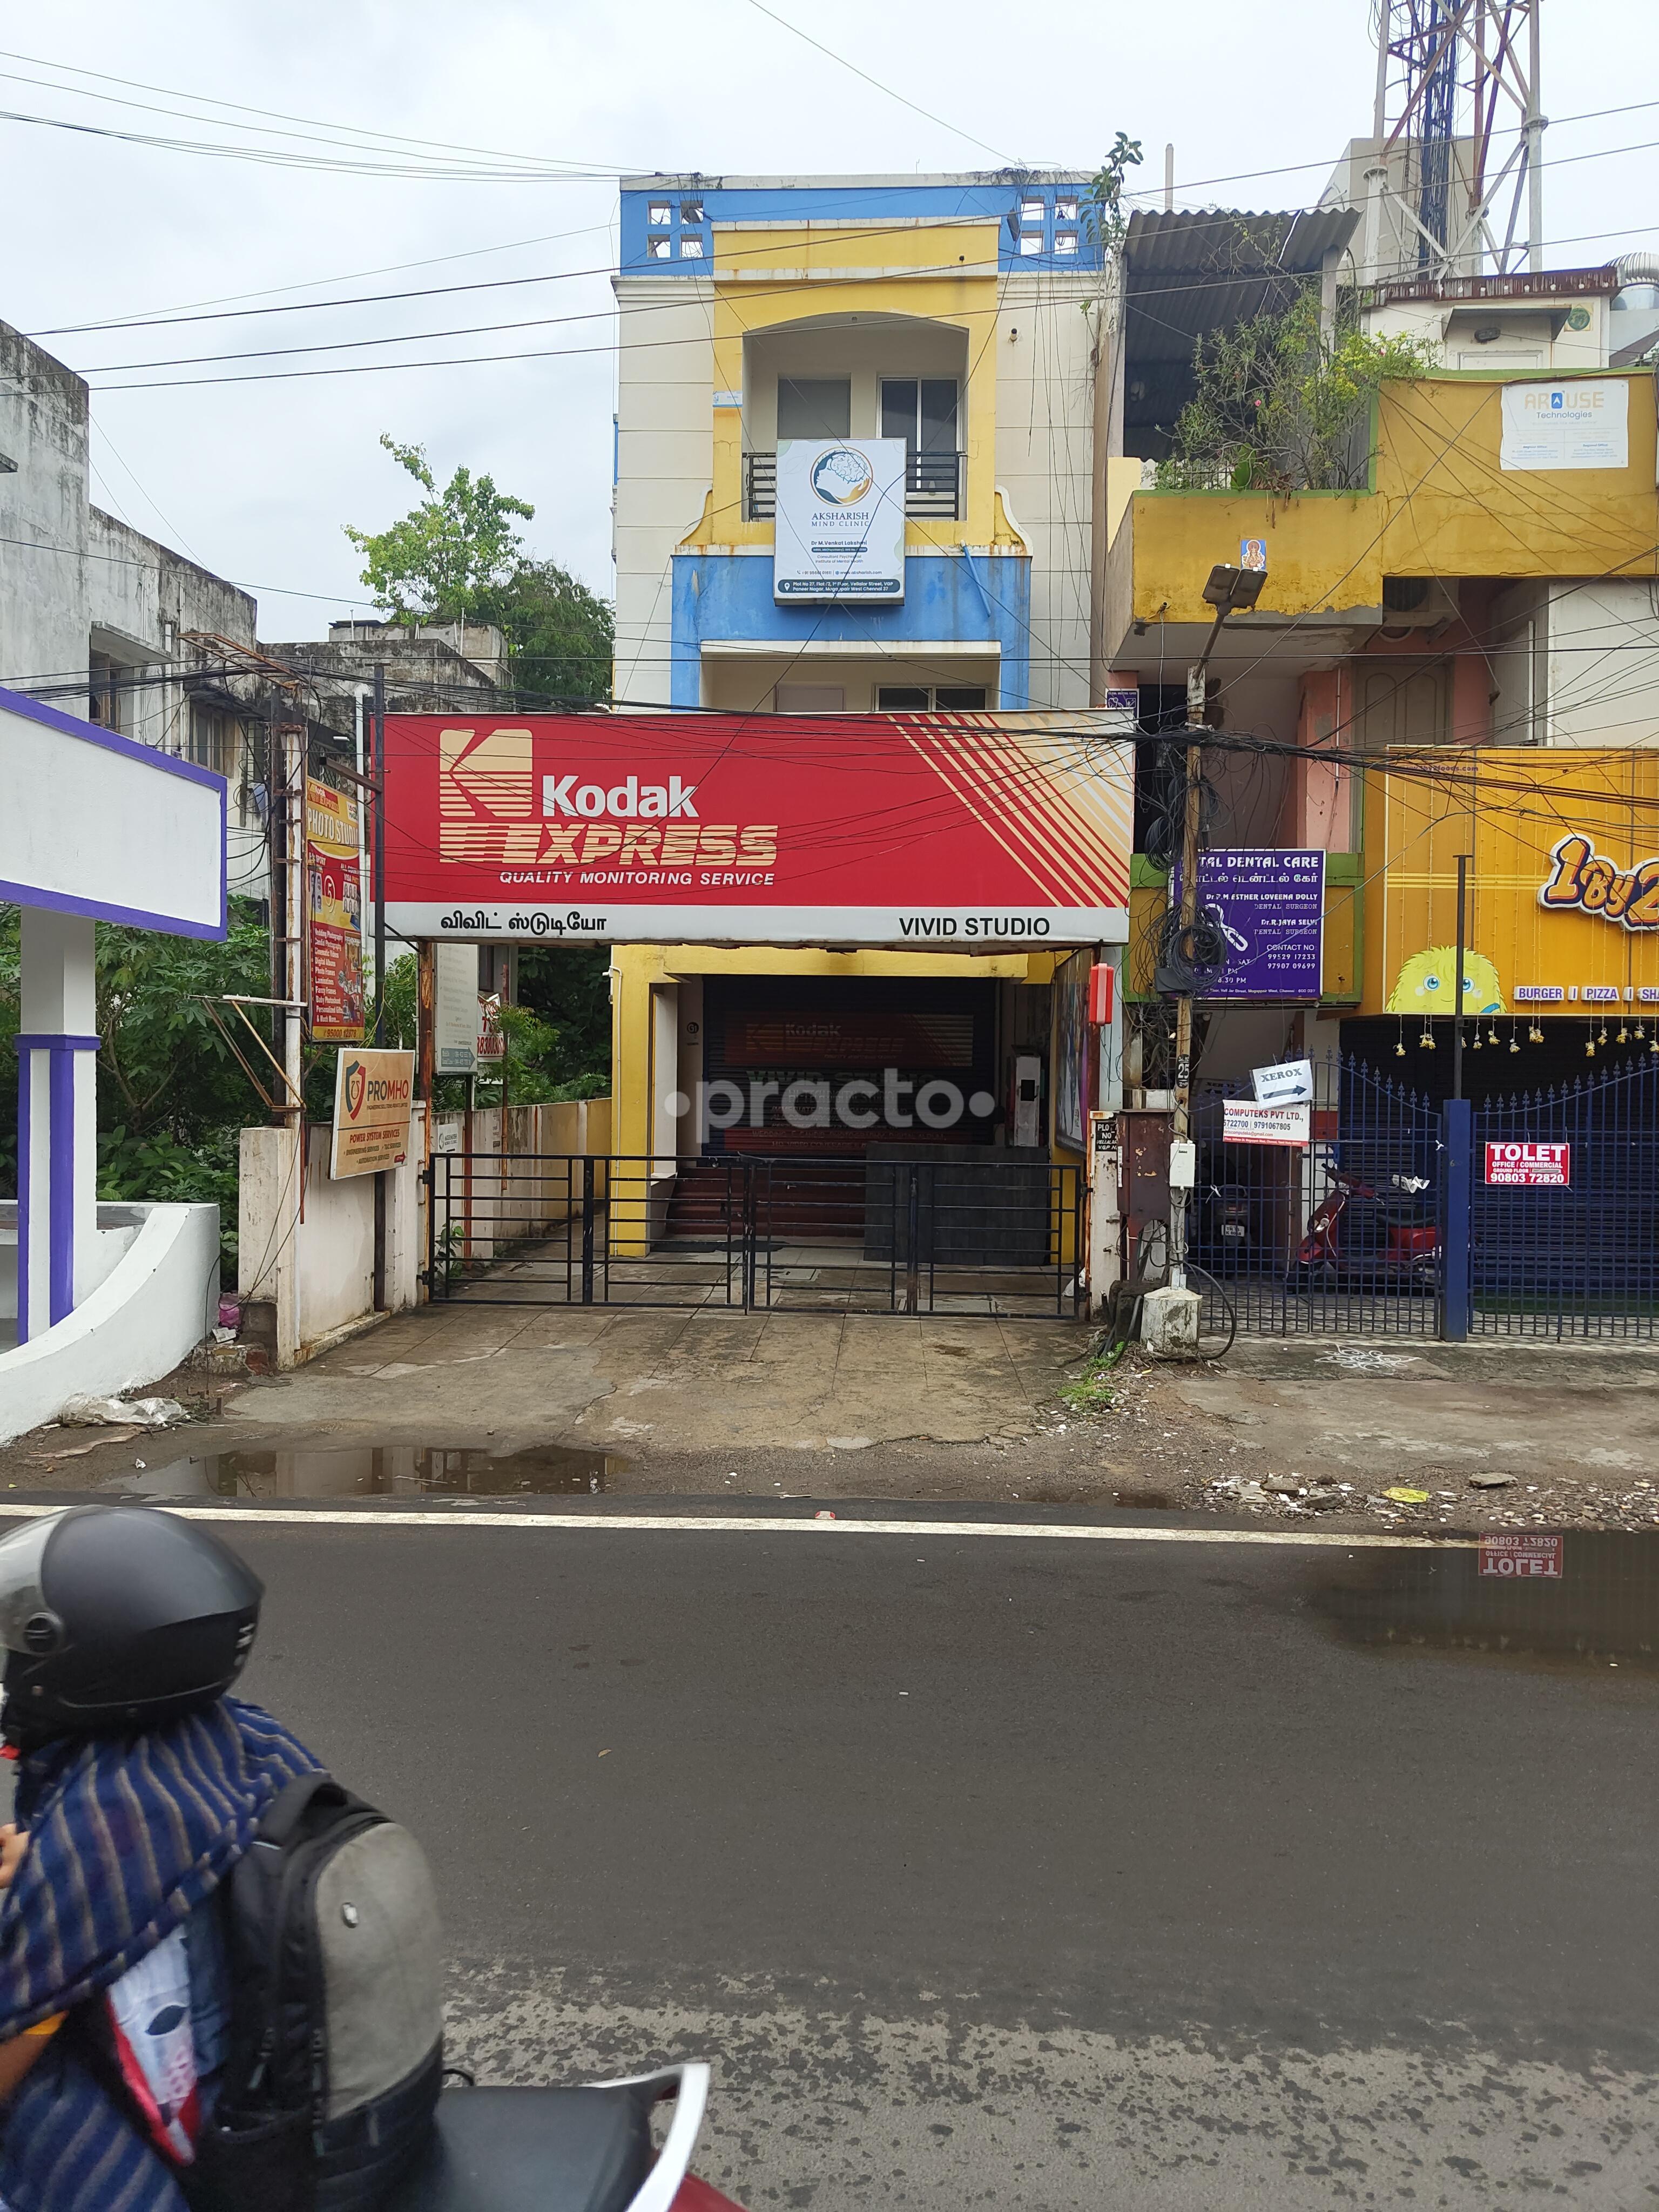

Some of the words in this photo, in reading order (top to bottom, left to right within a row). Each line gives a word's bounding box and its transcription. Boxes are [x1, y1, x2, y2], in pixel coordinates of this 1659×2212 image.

[1536, 411, 1593, 420] Technologies
[811, 512, 869, 520] AKSHARISH
[543, 775, 699, 818] Kodak
[307, 807, 335, 841] PHOTO
[440, 822, 778, 867] EXPRESS
[1227, 857, 1280, 868] DENTAL
[1284, 857, 1319, 868] CARE
[500, 870, 574, 885] QUALITY
[580, 871, 692, 886] MONITORING
[700, 872, 775, 886] SERVICE
[441, 910, 502, 930] விவிட்
[509, 911, 607, 936] ஸ்டுடியோ
[899, 917, 957, 936] VIVID
[965, 917, 1050, 936] STUDIO
[1518, 987, 1563, 999] BURGER
[1586, 988, 1617, 999] PIZZA
[327, 1028, 342, 1037] 95000
[785, 1022, 842, 1037] Kodak
[1178, 1063, 1190, 1079] 25
[1260, 1068, 1303, 1083] XEROX
[367, 1079, 409, 1102] PROMHO
[1224, 1108, 1269, 1118] COMPUTEKS
[1270, 1111, 1284, 1119] PVT
[1254, 1122, 1291, 1130] 9791067805
[349, 1132, 366, 1144] POWER
[366, 1131, 382, 1142] SYSTEM
[382, 1129, 400, 1139] SERVICES
[1490, 1144, 1566, 1162] TOLET
[1490, 1173, 1526, 1183] 90803
[1529, 1174, 1564, 1183] 72820
